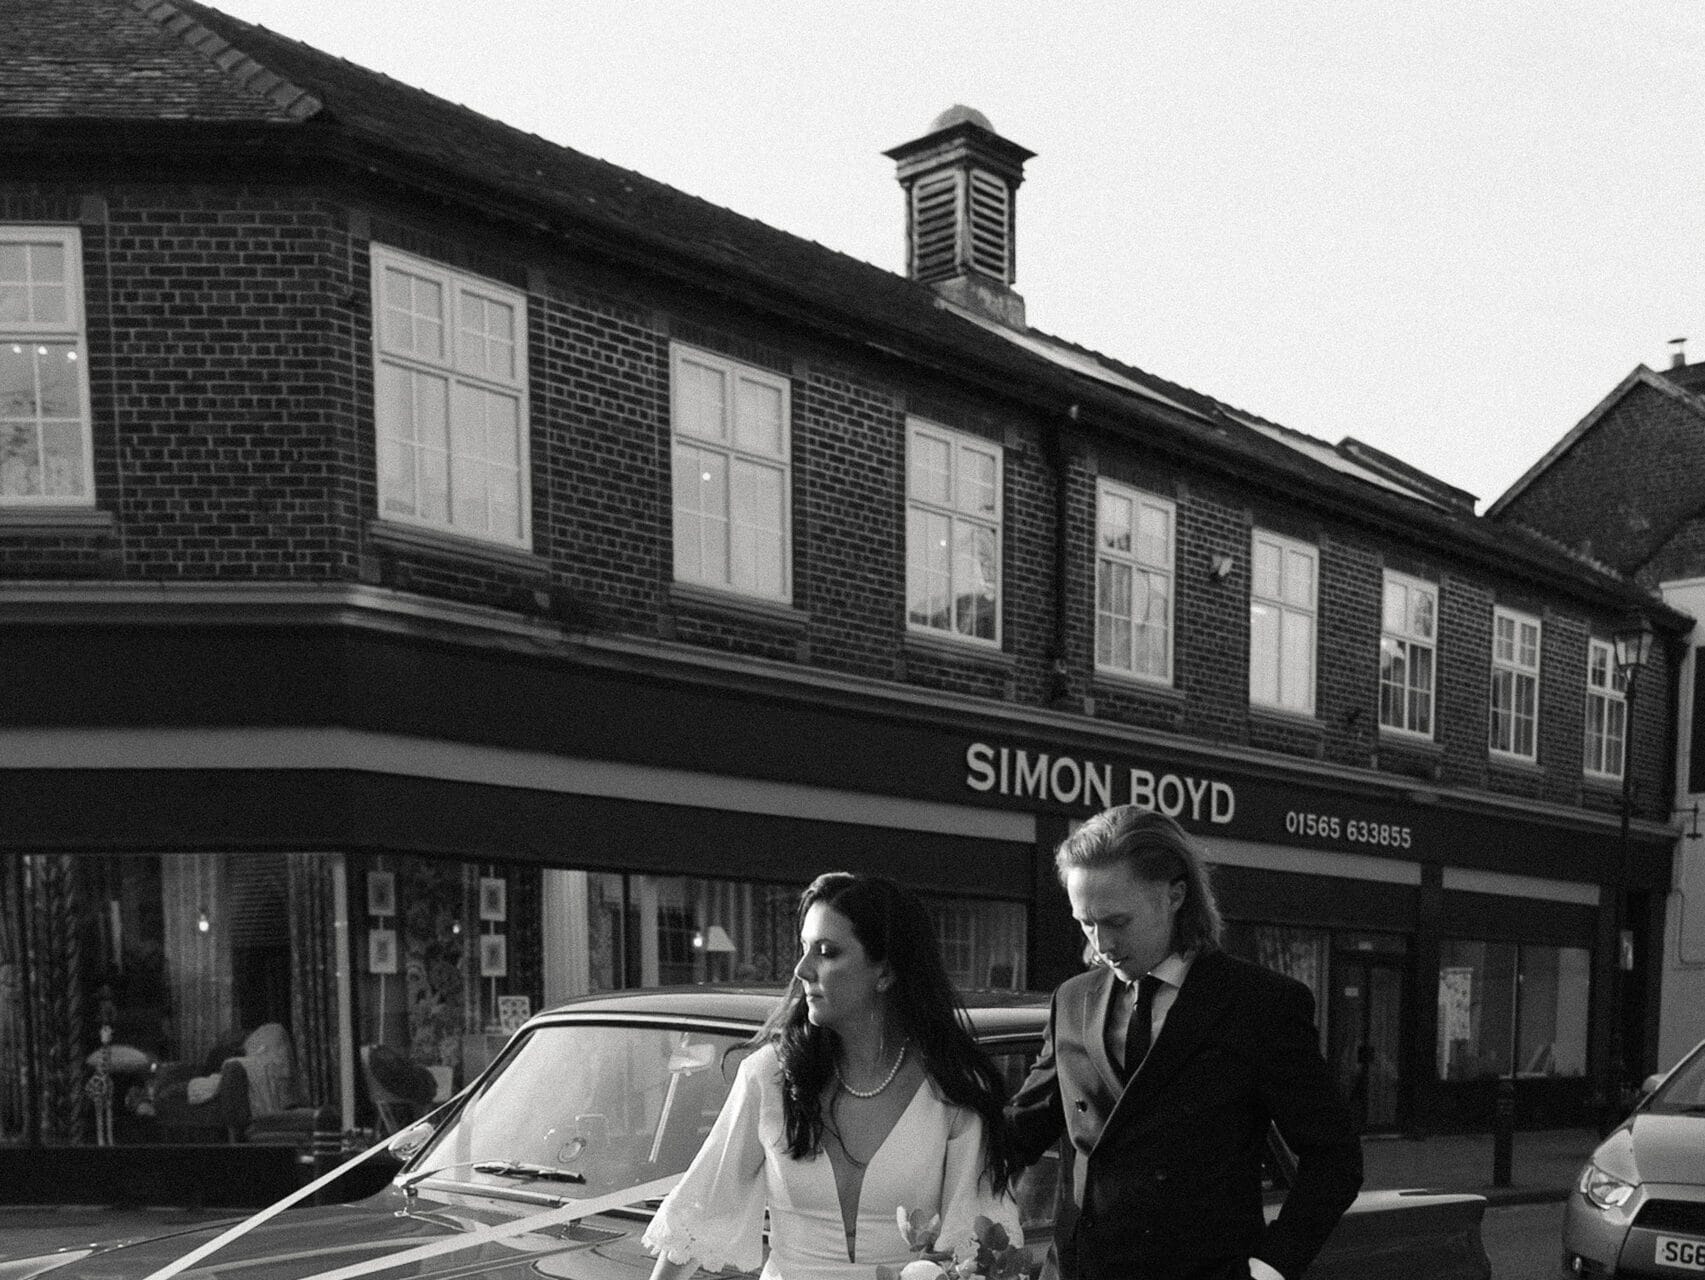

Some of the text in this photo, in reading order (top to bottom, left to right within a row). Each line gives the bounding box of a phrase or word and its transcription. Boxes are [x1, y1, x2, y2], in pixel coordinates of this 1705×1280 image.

[966, 742, 1236, 824] SIMON BOYD
[1286, 811, 1412, 848] 01565 633855
